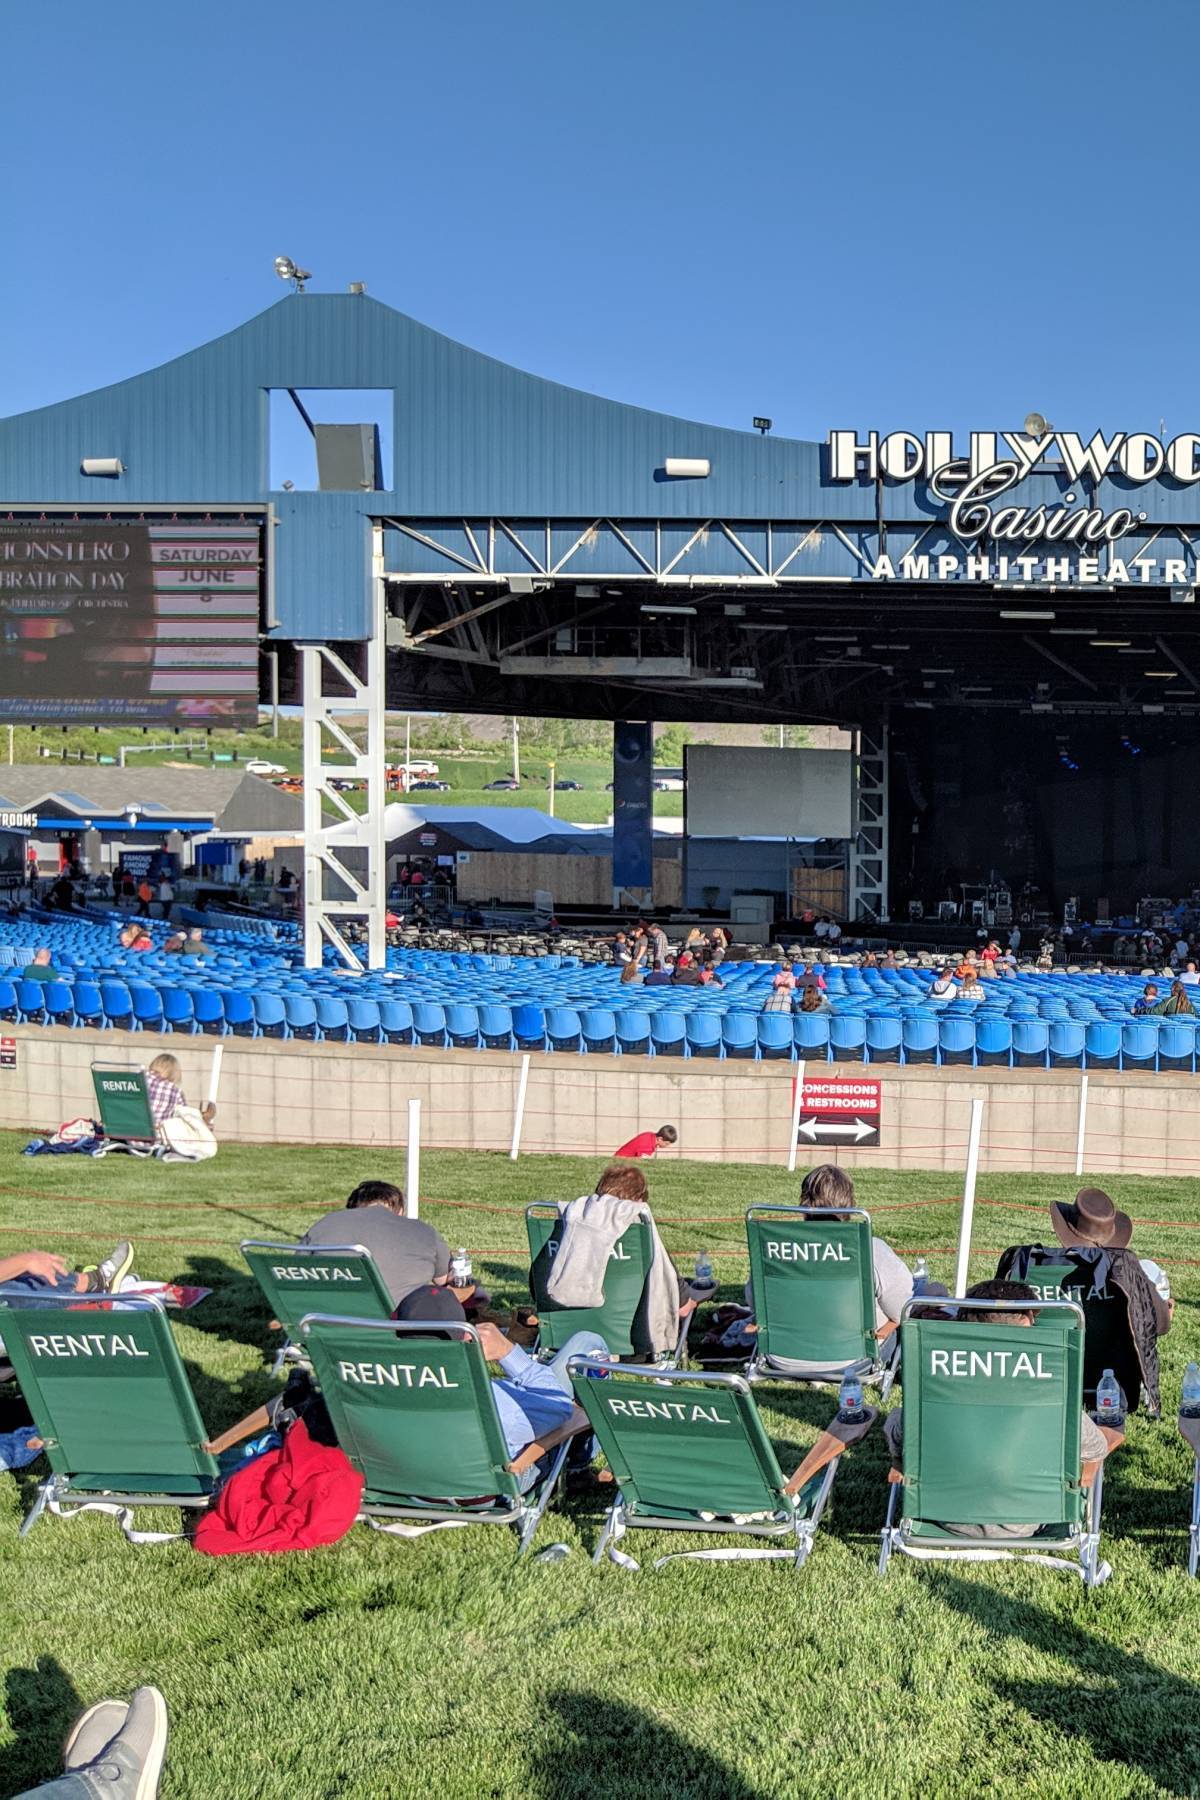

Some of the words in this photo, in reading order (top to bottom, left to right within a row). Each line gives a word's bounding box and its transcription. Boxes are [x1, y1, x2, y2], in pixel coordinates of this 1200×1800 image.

[932, 459, 1137, 542] Casino
[160, 550, 253, 562] SATURDAY
[91, 571, 129, 590] DAY
[178, 569, 235, 583] JUNE
[0, 813, 38, 827] ROOMS
[102, 1080, 140, 1092] RENTAL
[807, 1098, 877, 1108] RESTROOMS
[548, 1240, 631, 1260] RAL
[767, 1241, 851, 1262] RENTAL
[271, 1266, 362, 1282] RENTAL
[29, 1334, 150, 1358] RENTAL
[931, 1349, 1053, 1379] RENTAL
[338, 1361, 459, 1389] RENTAL
[608, 1398, 731, 1425] RENTAL
